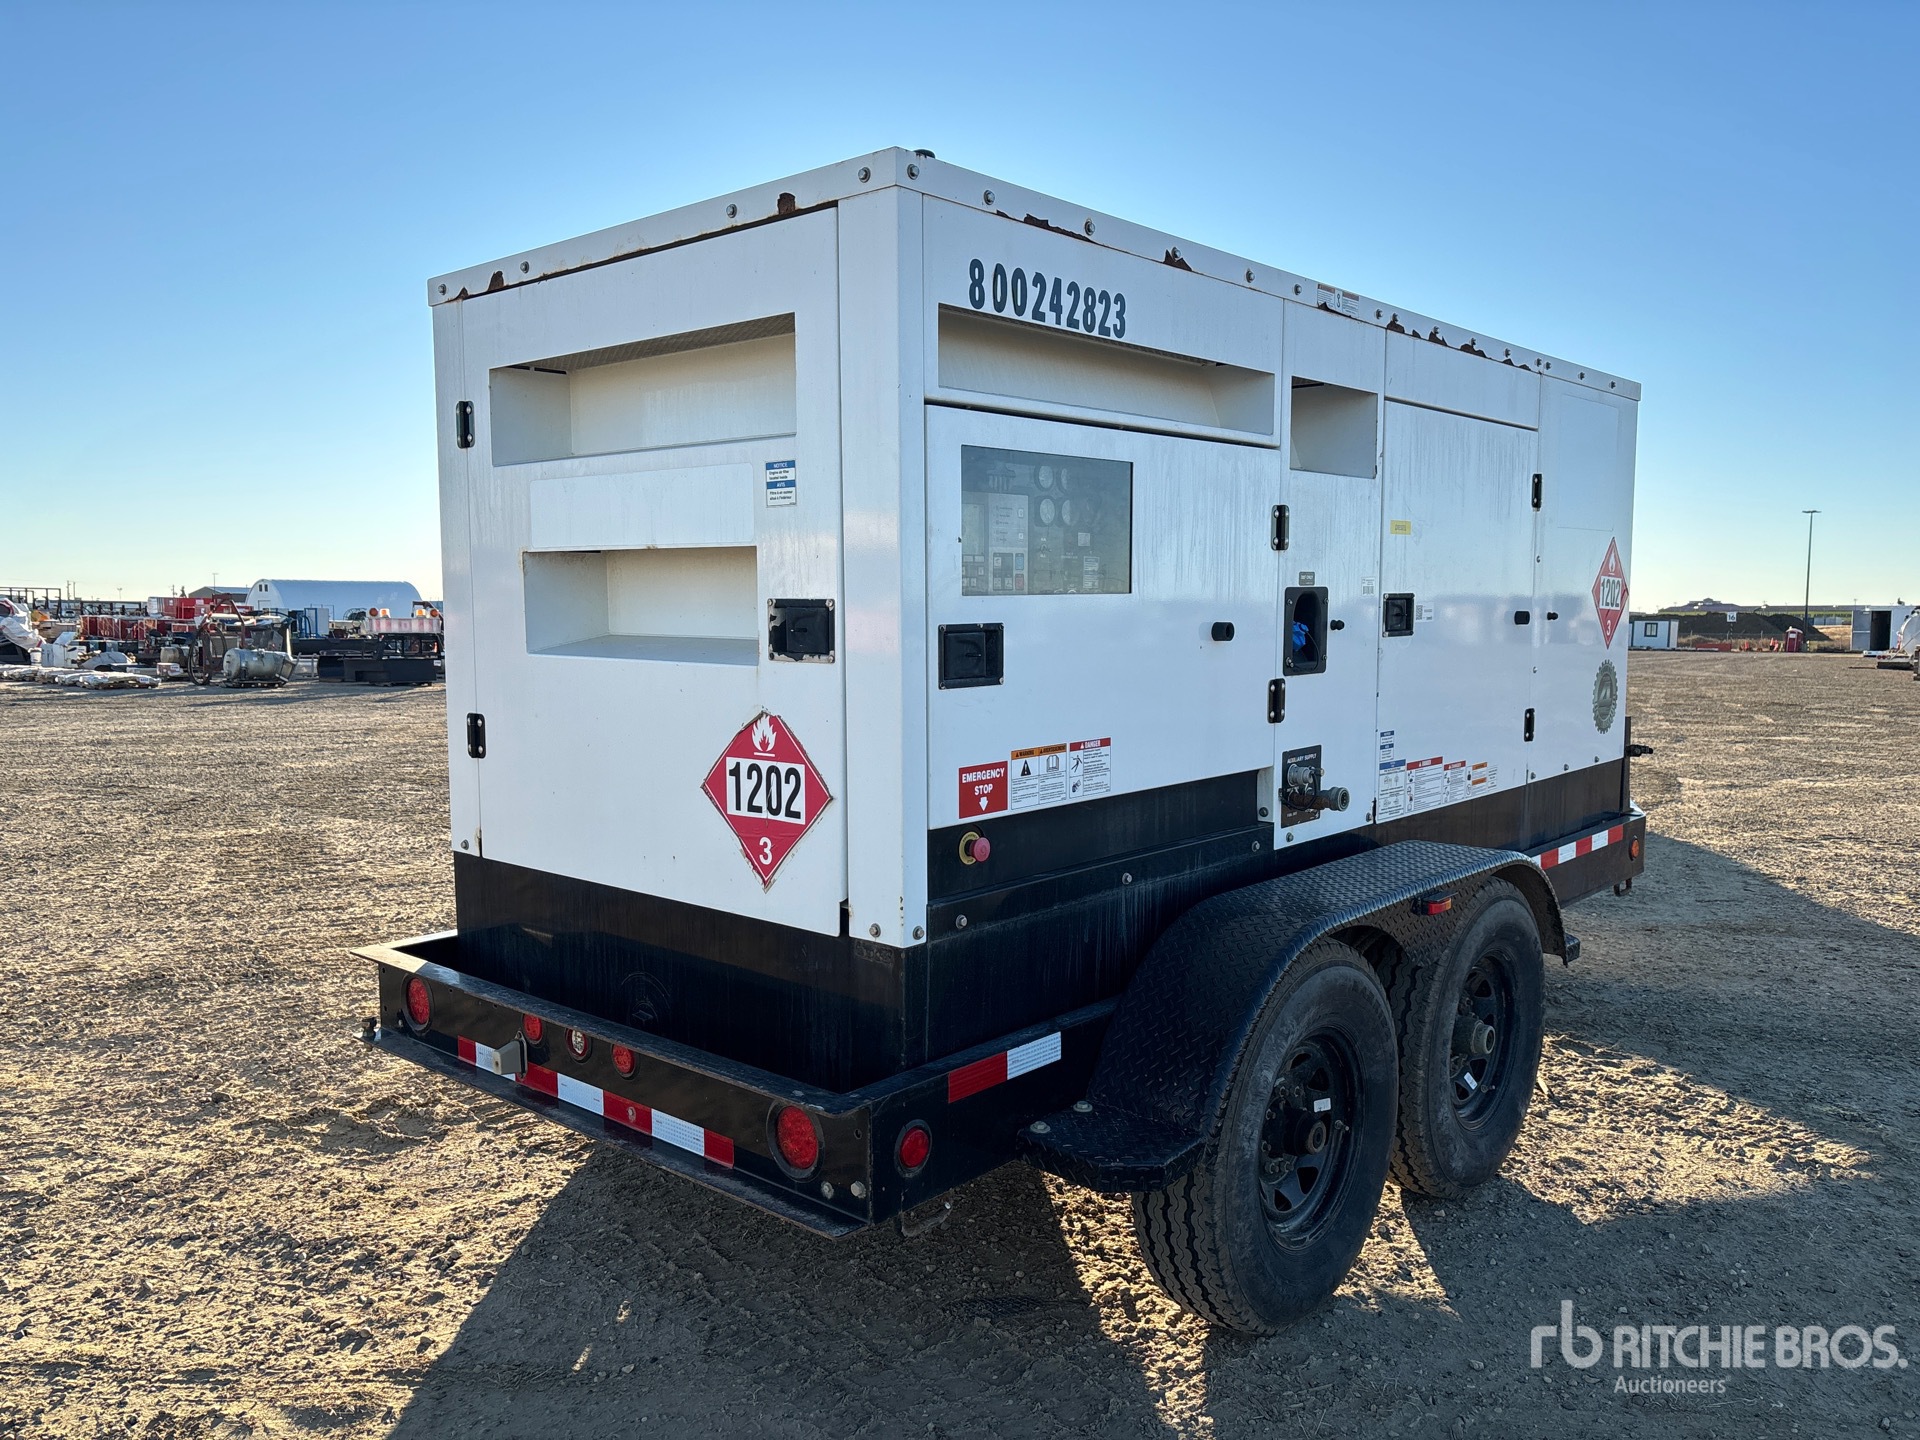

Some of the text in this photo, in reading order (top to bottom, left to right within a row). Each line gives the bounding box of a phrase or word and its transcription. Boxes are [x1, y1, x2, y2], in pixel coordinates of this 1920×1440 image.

[969, 258, 1126, 339] 800242823
[1601, 577, 1621, 608] 1202
[1606, 620, 1611, 636] 3
[1084, 740, 1101, 749] DANGER
[961, 767, 1005, 784] EMERGENCY
[728, 761, 802, 820] 1202
[974, 783, 994, 796] STOP
[758, 836, 773, 866] 3
